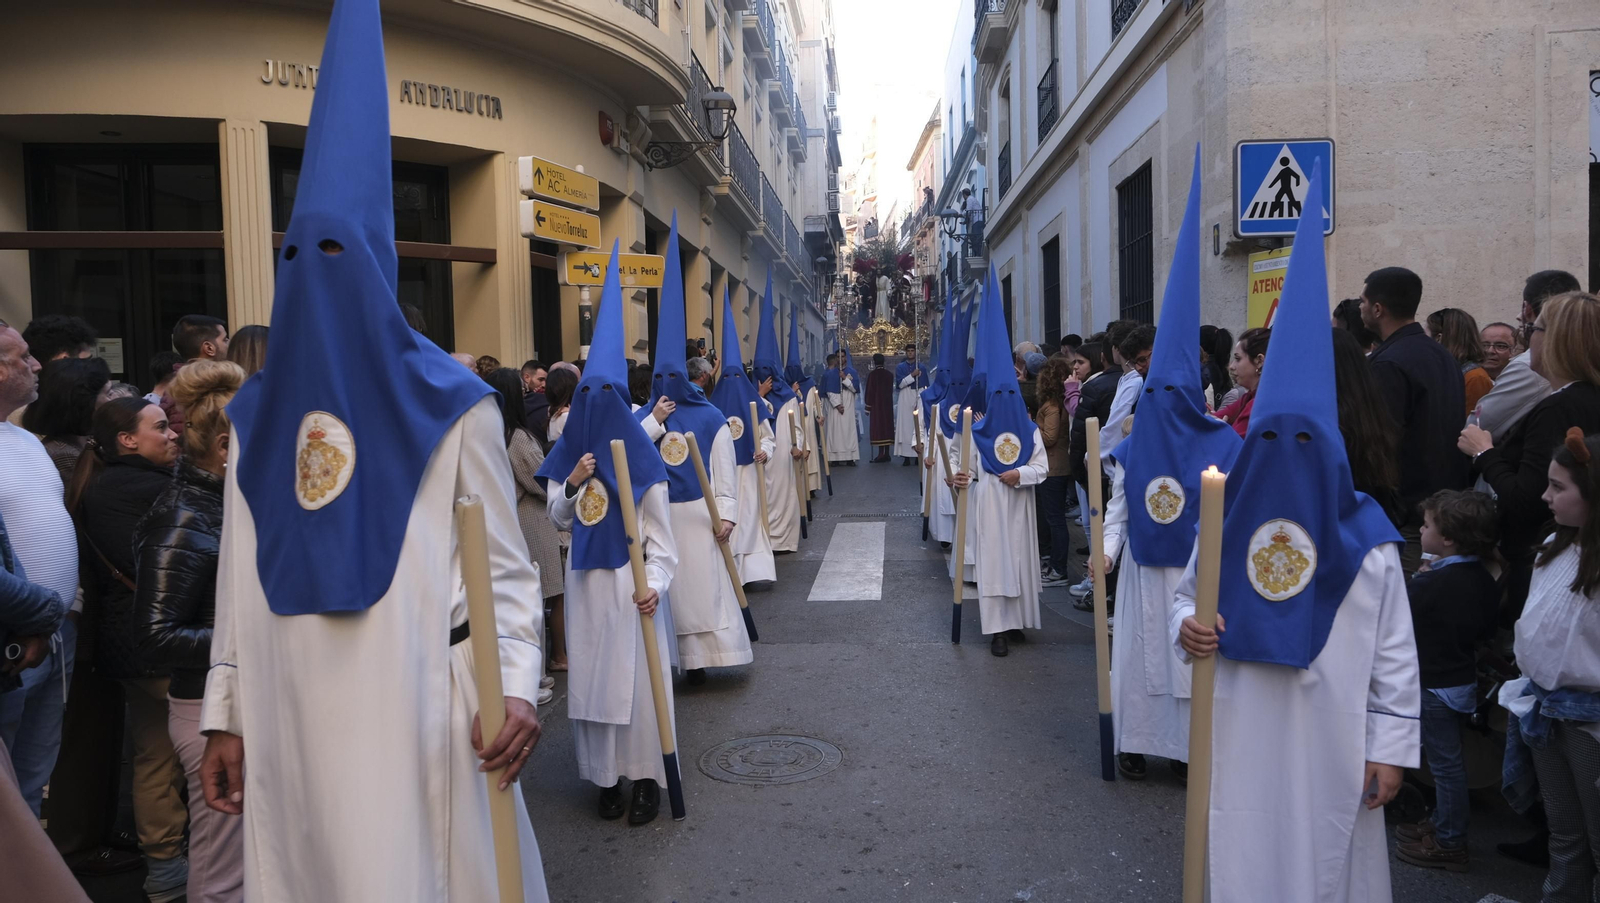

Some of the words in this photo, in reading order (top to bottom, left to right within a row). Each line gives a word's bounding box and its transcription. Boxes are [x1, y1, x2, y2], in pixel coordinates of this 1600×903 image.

[261, 59, 319, 89] JUNT
[400, 79, 503, 120] ANDALUCIA
[546, 167, 566, 182] HOTEL
[547, 178, 560, 193] AC
[629, 266, 637, 275] La
[641, 266, 658, 276] Perla
[1252, 276, 1284, 294] ATENC
